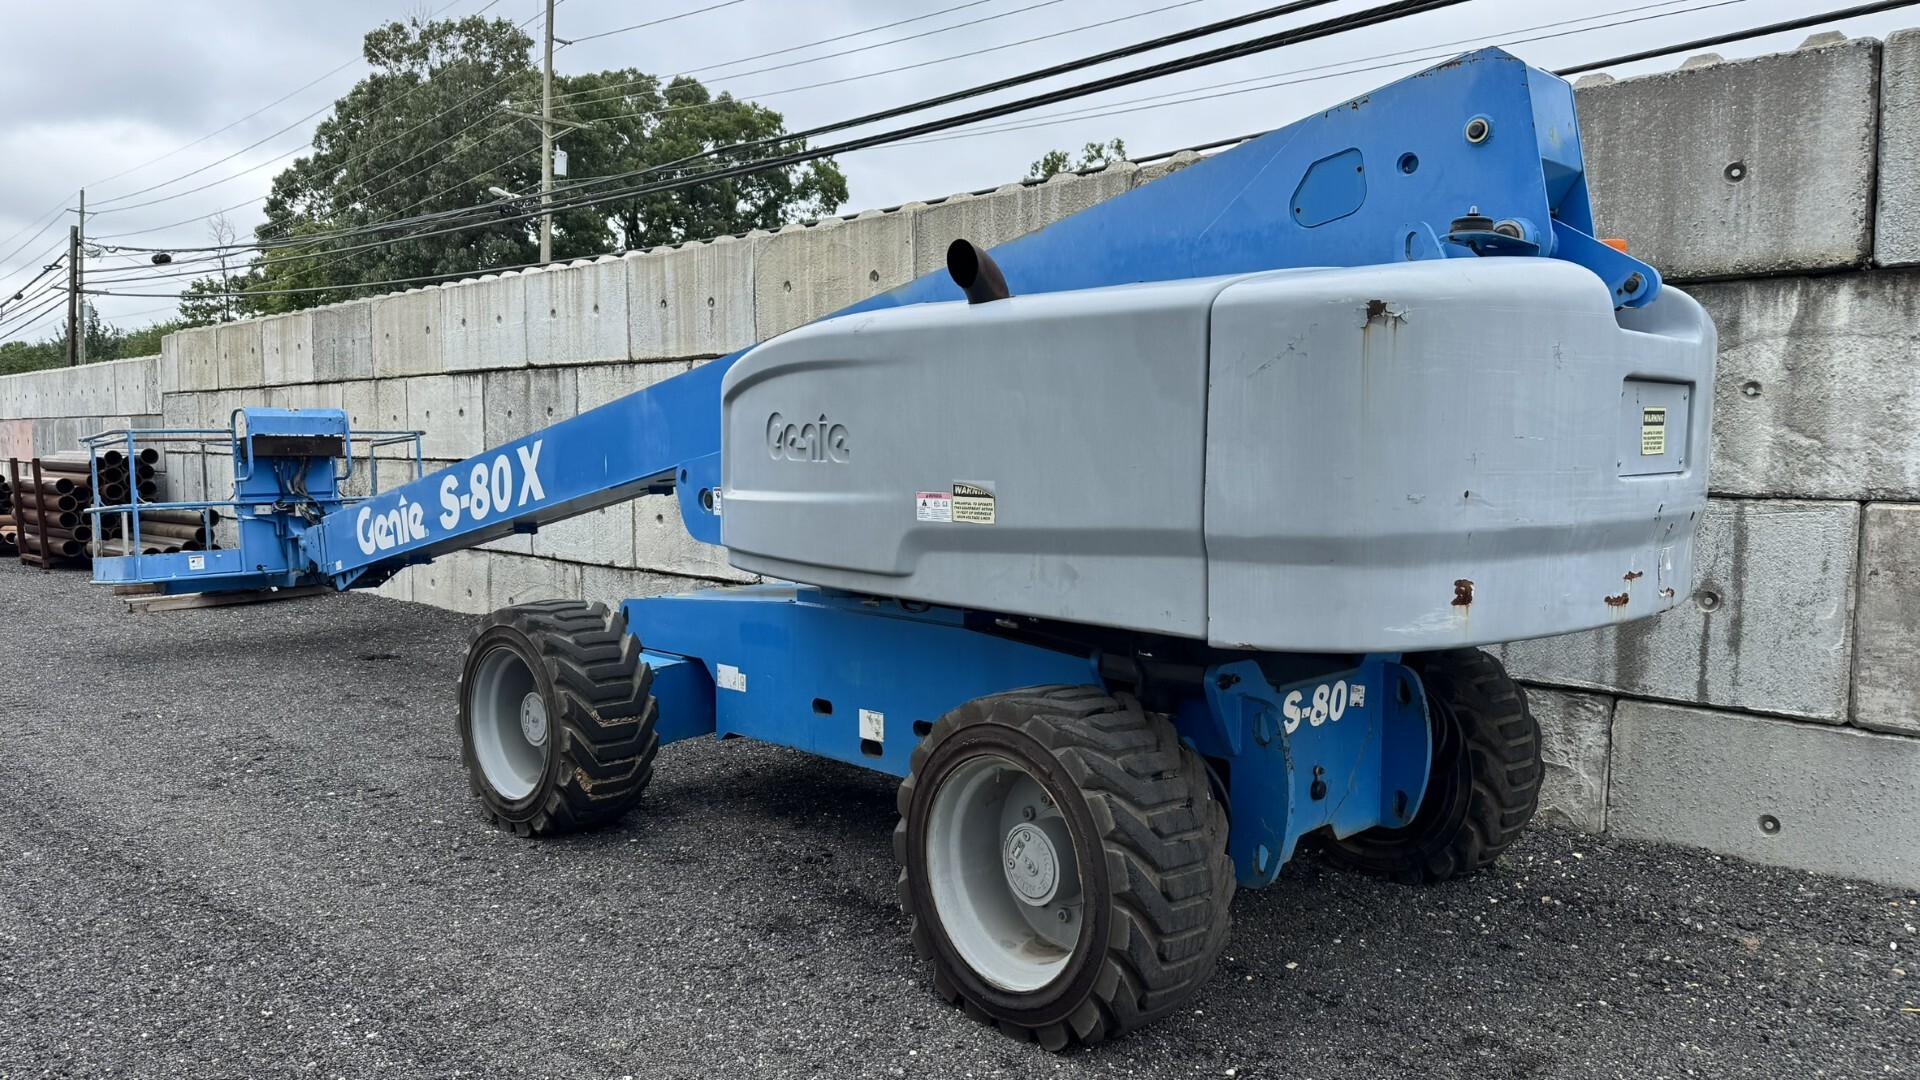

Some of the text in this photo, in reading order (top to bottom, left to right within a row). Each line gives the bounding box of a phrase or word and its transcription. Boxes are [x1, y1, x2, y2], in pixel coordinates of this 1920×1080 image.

[766, 411, 850, 464] Genie
[1644, 414, 1664, 422] WARNING
[356, 439, 545, 555] Genie S-80 X
[1283, 679, 1347, 735] S-80
